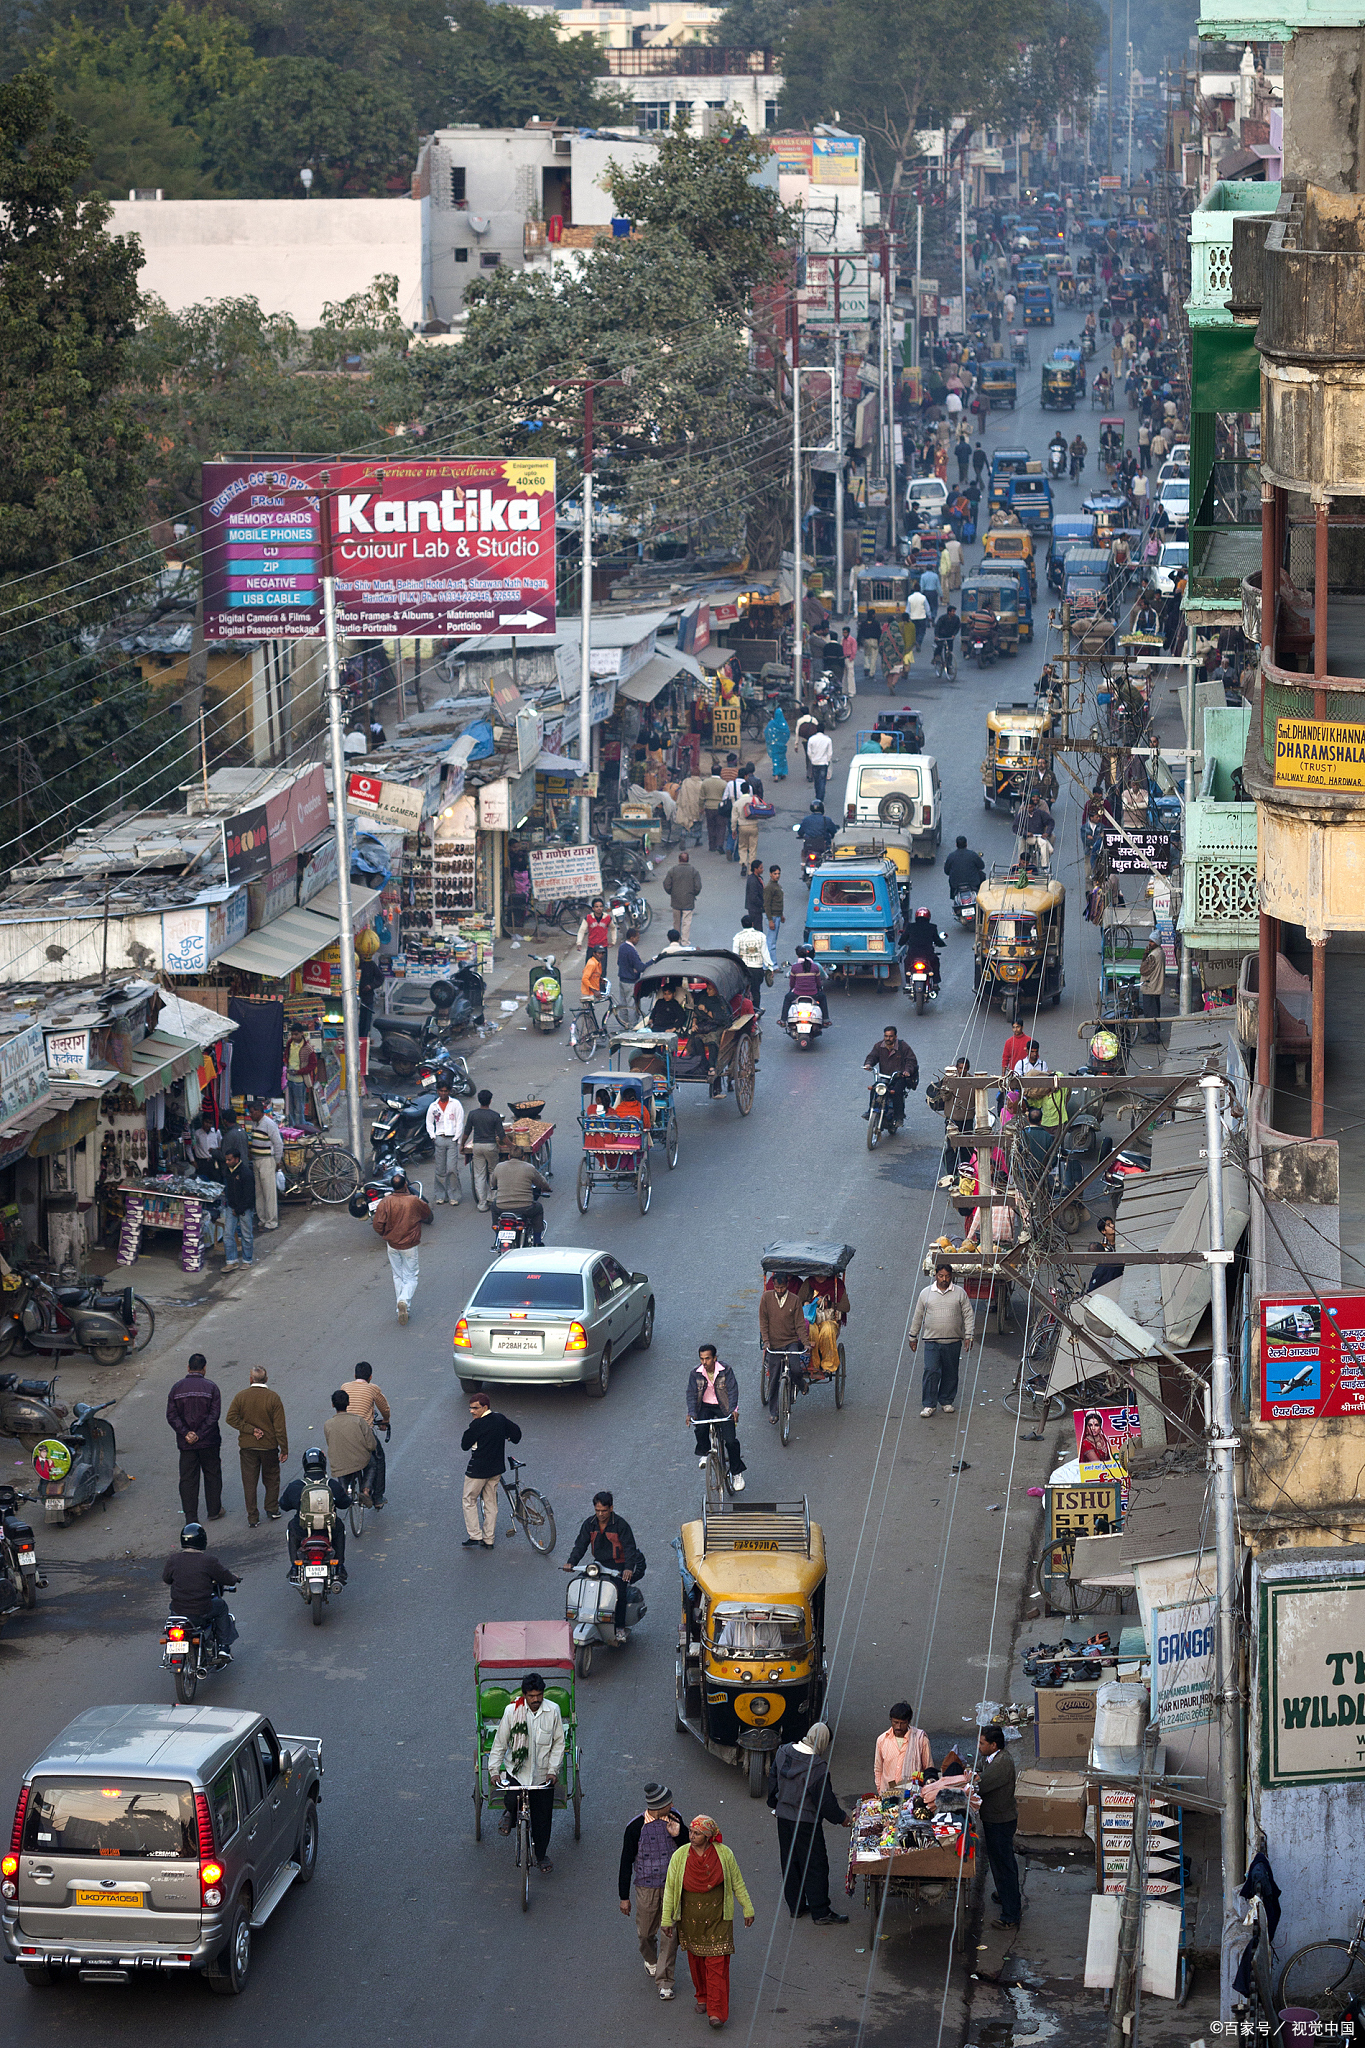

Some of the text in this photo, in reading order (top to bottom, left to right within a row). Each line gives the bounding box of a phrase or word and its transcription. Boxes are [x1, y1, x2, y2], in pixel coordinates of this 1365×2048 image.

[425, 466, 437, 477] in
[441, 464, 498, 479] Excellence
[516, 476, 545, 486] 40x60
[208, 471, 288, 518] DIGITAL COOR
[338, 489, 541, 533] Kantika
[229, 513, 312, 525] MEMORY CARDS
[229, 528, 313, 541] MOBILE PHONES
[341, 536, 540, 559] Colour Lab & Studio
[263, 562, 280, 572] ZIP
[246, 577, 297, 589] NEGATIVE
[243, 593, 301, 605] USB CABLE
[219, 612, 311, 624] Digital Camera & Films
[359, 611, 390, 620] Frames
[401, 611, 434, 620] Albums
[446, 610, 495, 619] Matrimonial
[219, 625, 320, 637] Digital Passport Package
[362, 623, 398, 633] Portraits
[446, 622, 482, 632] Portfolio
[1300, 761, 1337, 773] (TRUST)
[351, 789, 376, 800] vodafone
[390, 806, 418, 819] CAMERA
[306, 975, 327, 984] vodafone
[523, 1342, 537, 1350] 2144
[1268, 1346, 1287, 1358] रेलवे
[1056, 1491, 1110, 1510] ISHU
[1158, 1626, 1214, 1665] GANGA
[1105, 1796, 1135, 1805] COURIER
[1103, 1819, 1114, 1827] JOB
[1115, 1819, 1130, 1827] WORK
[1106, 1840, 1131, 1848] ONLY 10
[1107, 1863, 1124, 1872] DOWN
